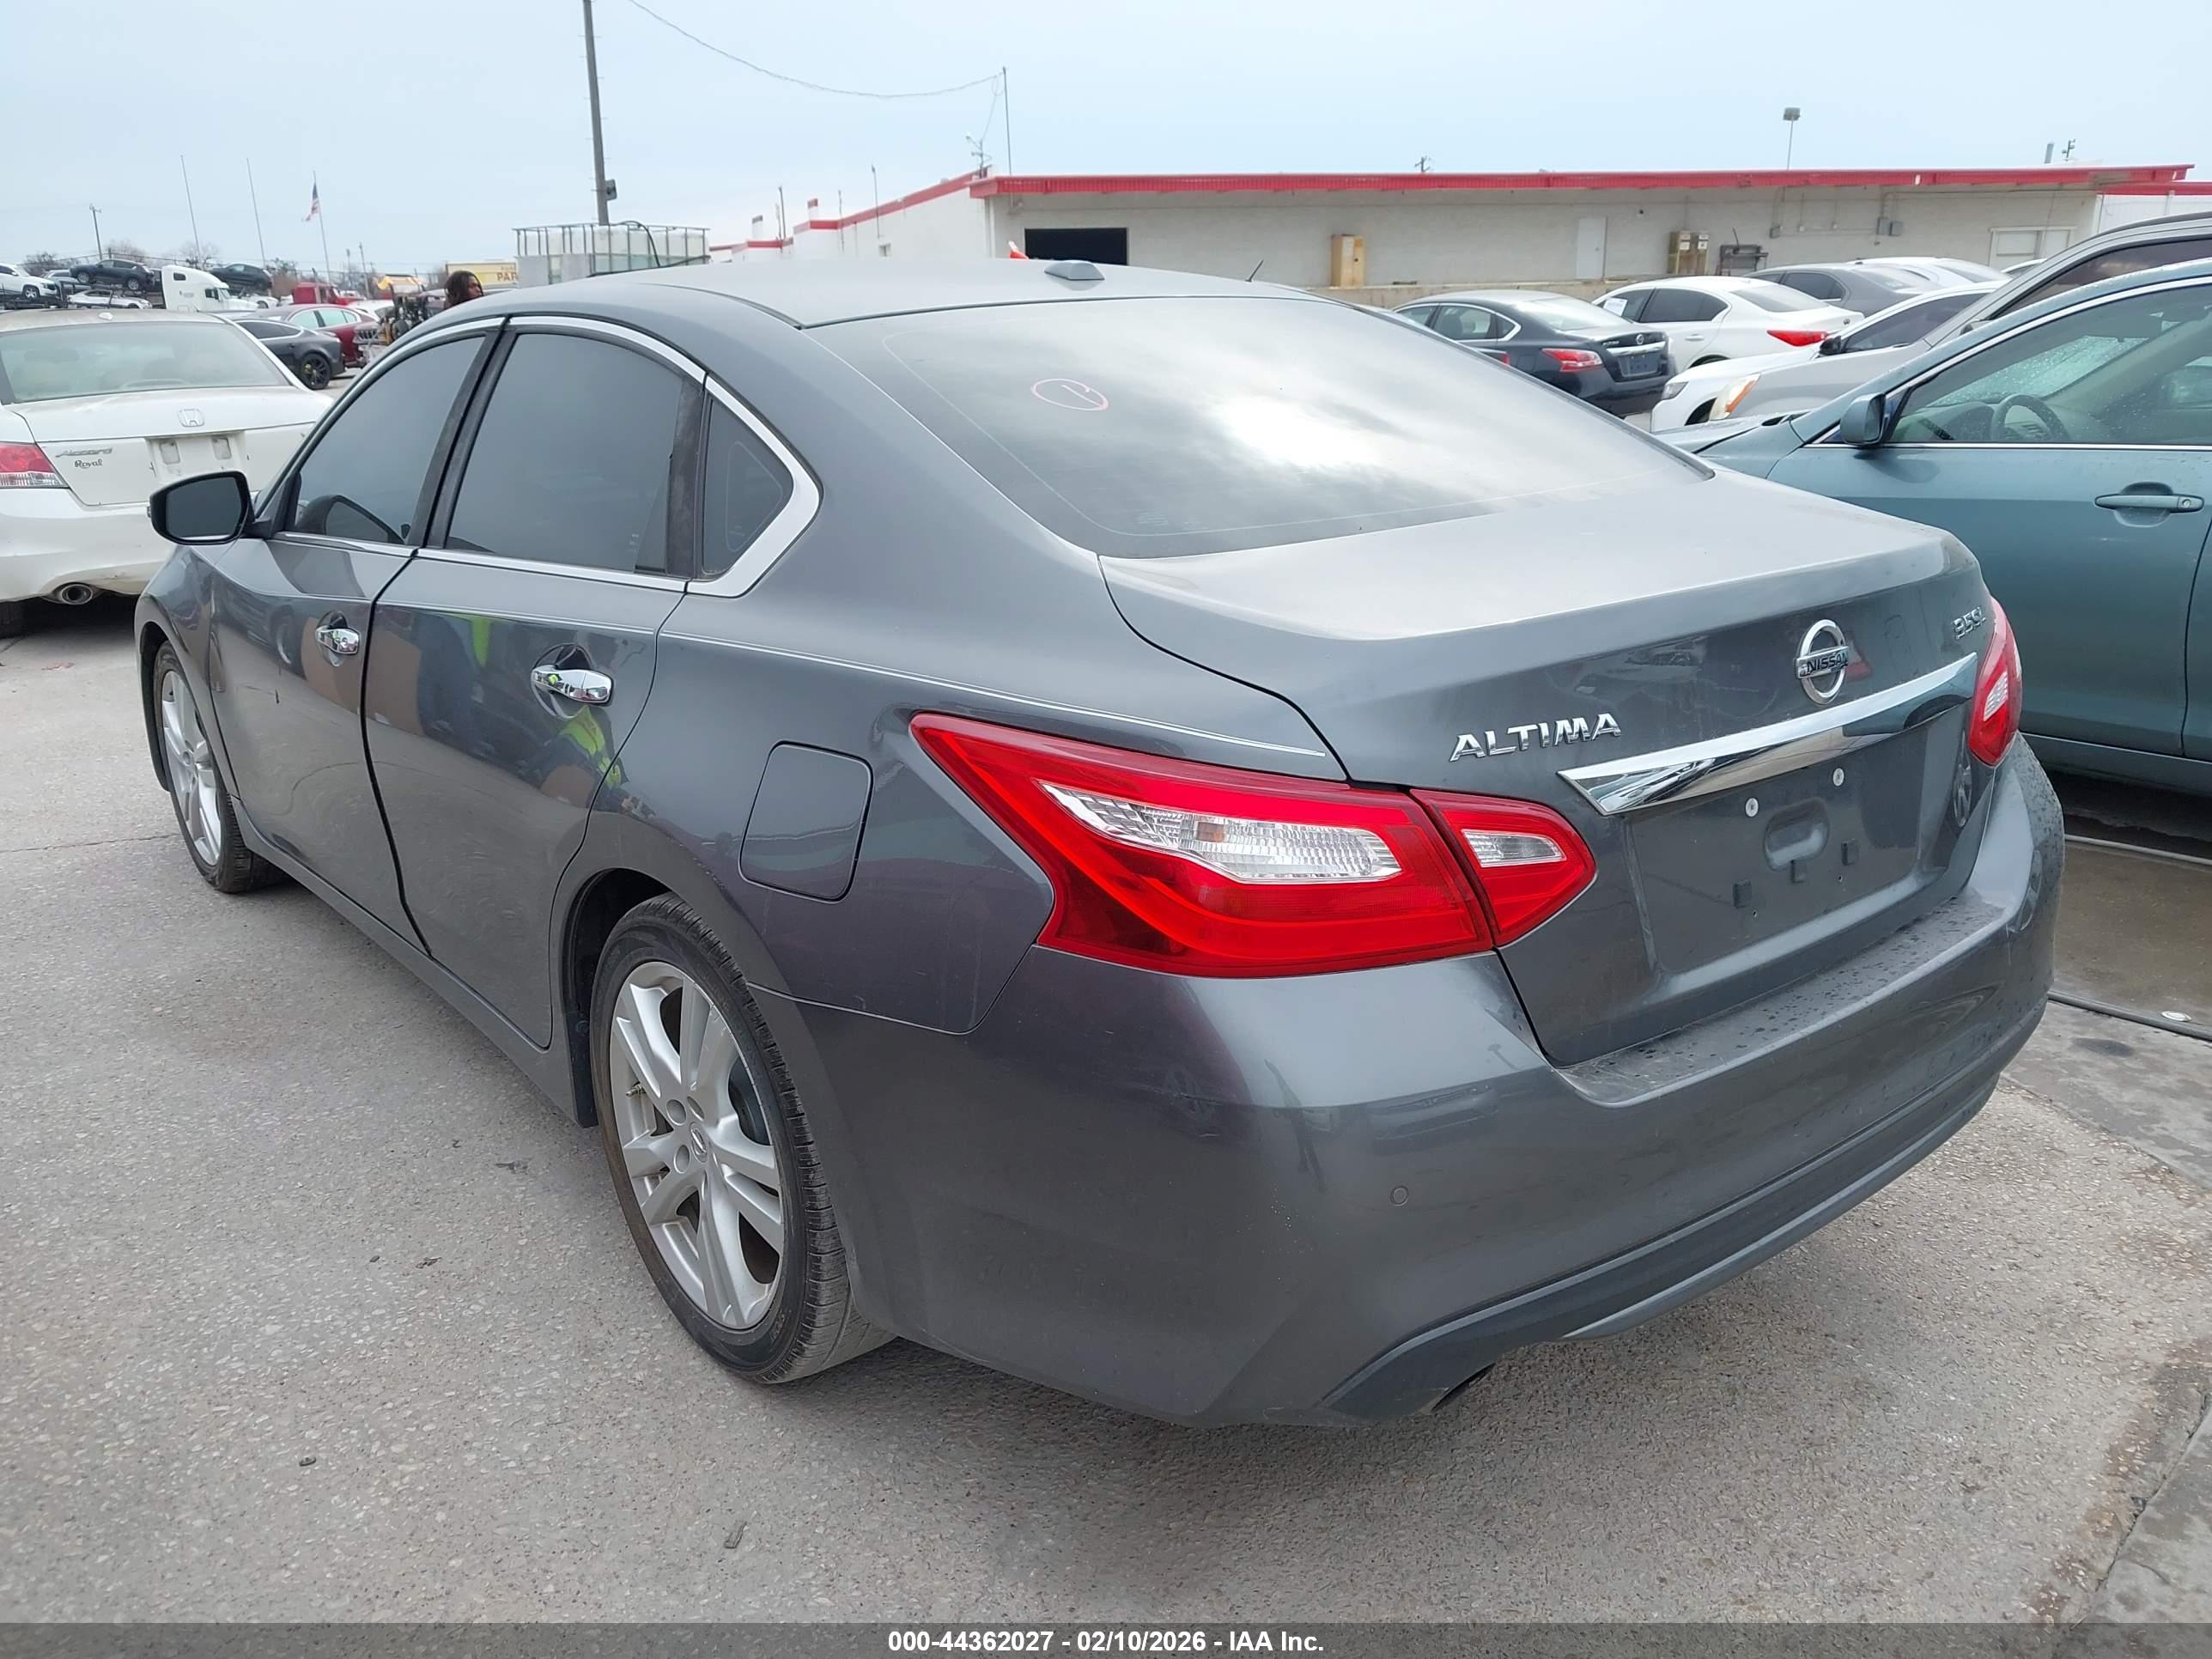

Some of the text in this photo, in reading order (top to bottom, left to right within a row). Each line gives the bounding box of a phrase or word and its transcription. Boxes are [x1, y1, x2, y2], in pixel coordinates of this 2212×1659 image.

[74, 459, 103, 470] Royal
[1807, 653, 1849, 672] NISSAN
[1449, 713, 1622, 762] ALTIMA
